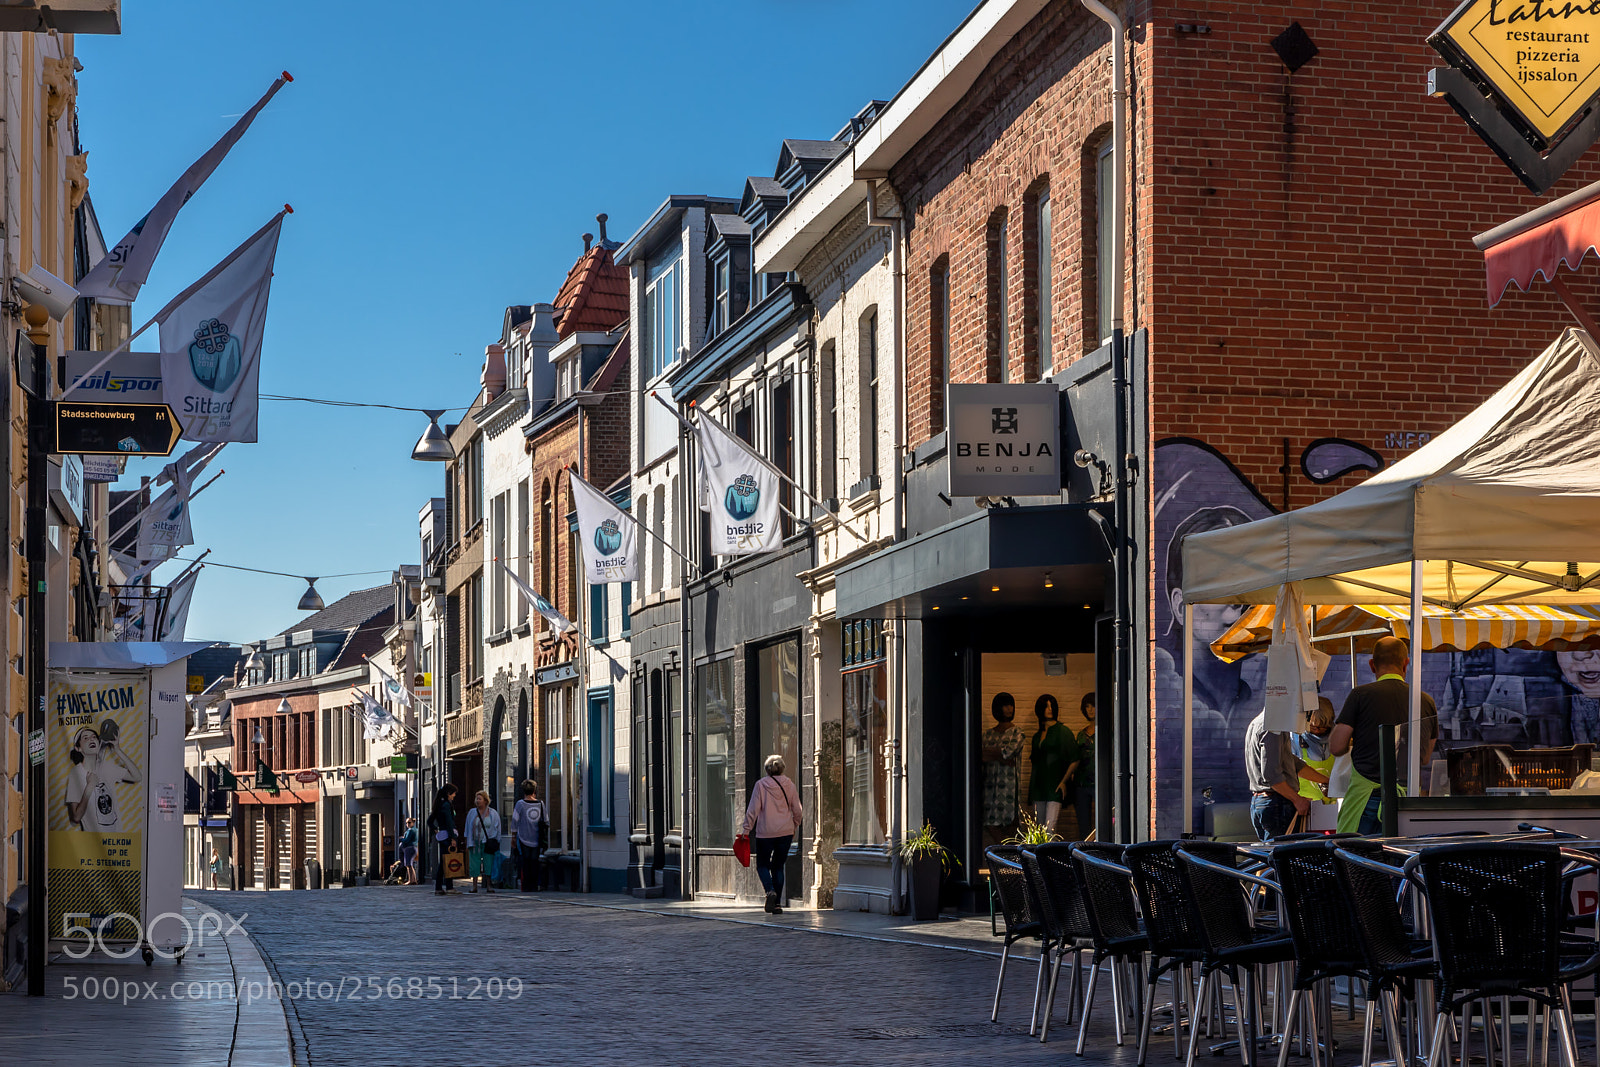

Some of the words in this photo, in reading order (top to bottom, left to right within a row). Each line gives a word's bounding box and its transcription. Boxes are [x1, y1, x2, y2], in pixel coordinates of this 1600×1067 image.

[1506, 30, 1590, 44] restaurant
[1516, 47, 1580, 65] pizzeria
[1517, 66, 1578, 85] ijssalon
[61, 409, 135, 421] Stadsschouwburg
[183, 414, 219, 436] 775
[957, 442, 1053, 457] BENJA
[976, 465, 1035, 473] MODE
[57, 686, 134, 715] #WELKOM
[158, 691, 179, 703] Wilsport
[65, 715, 93, 726] SITTARD
[102, 838, 131, 846] WELKOM
[96, 859, 131, 867] STEENWEG
